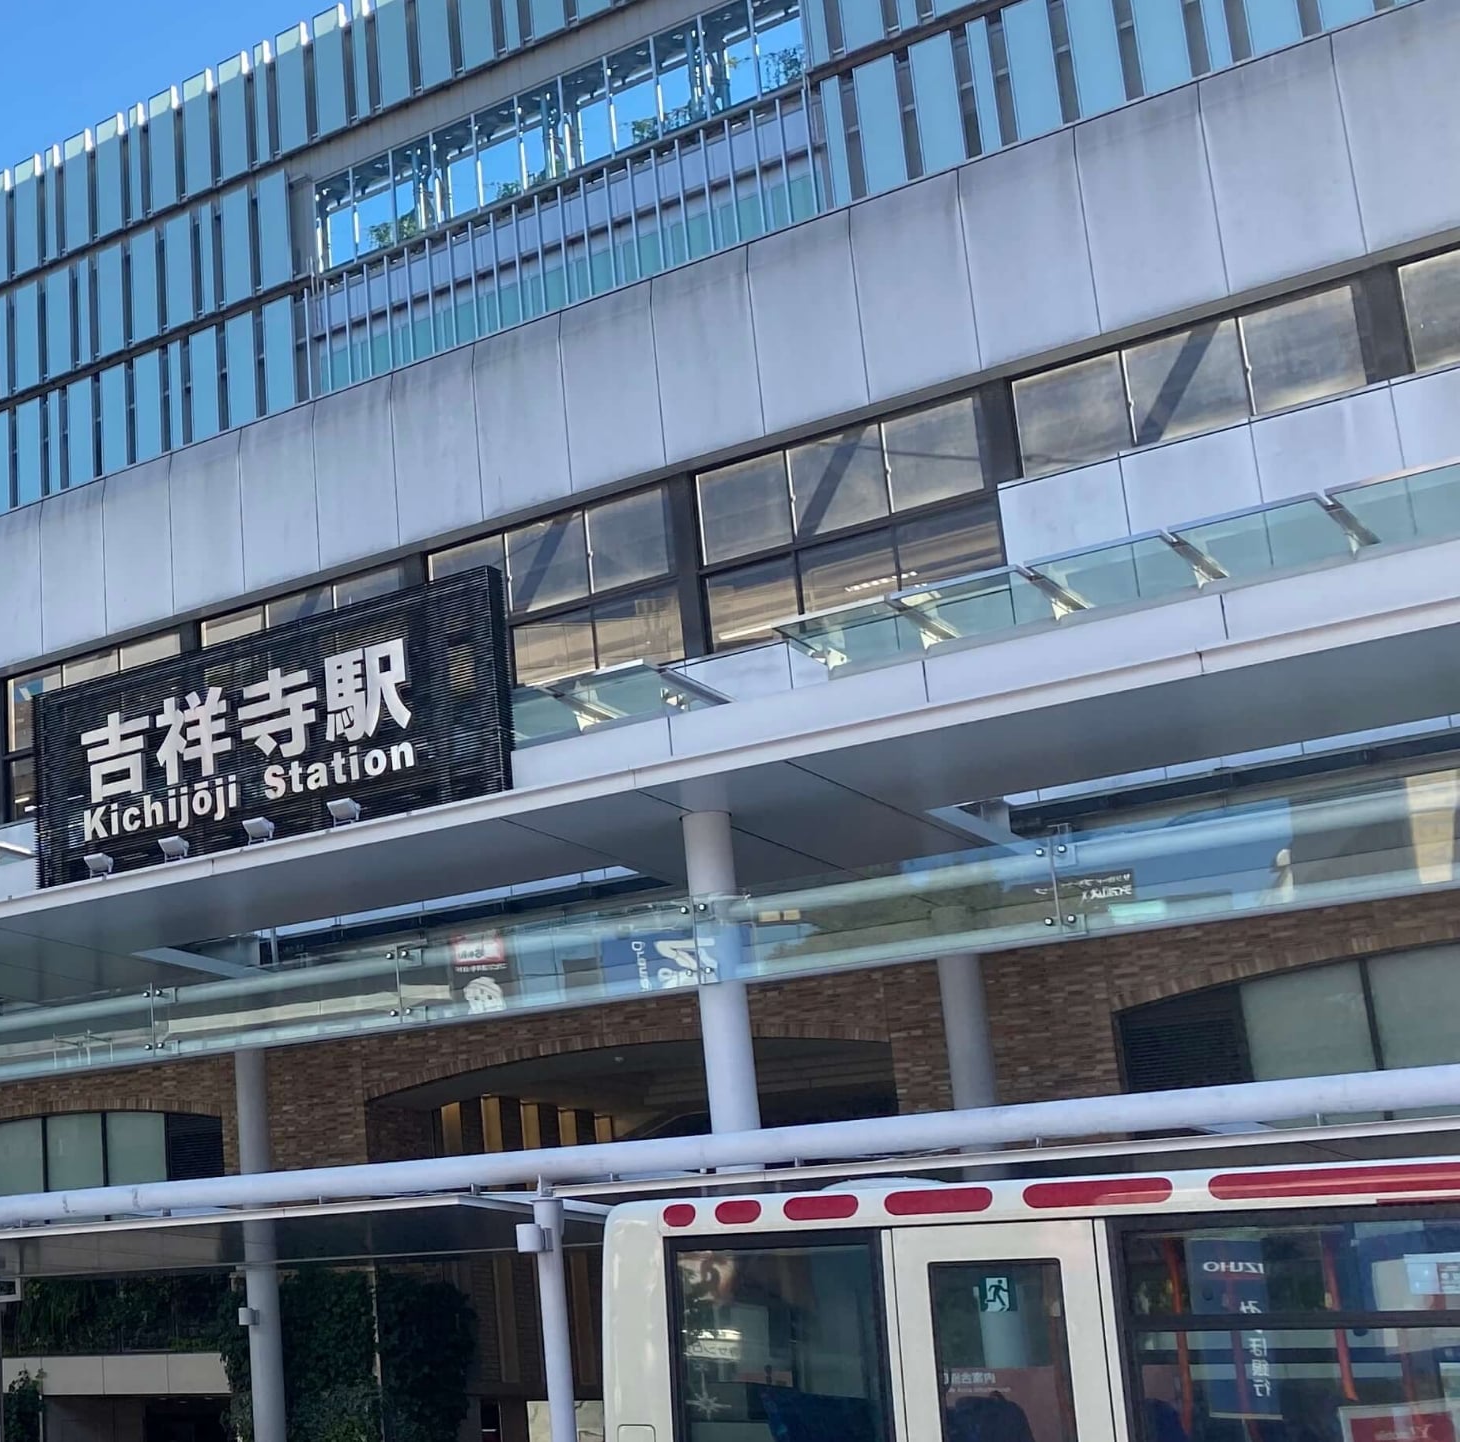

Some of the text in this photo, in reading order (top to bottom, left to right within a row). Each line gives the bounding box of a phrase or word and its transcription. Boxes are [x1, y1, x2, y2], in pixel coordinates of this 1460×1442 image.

[81, 637, 413, 804] 吉祥寺駅
[83, 740, 416, 843] Kichijōji Station
